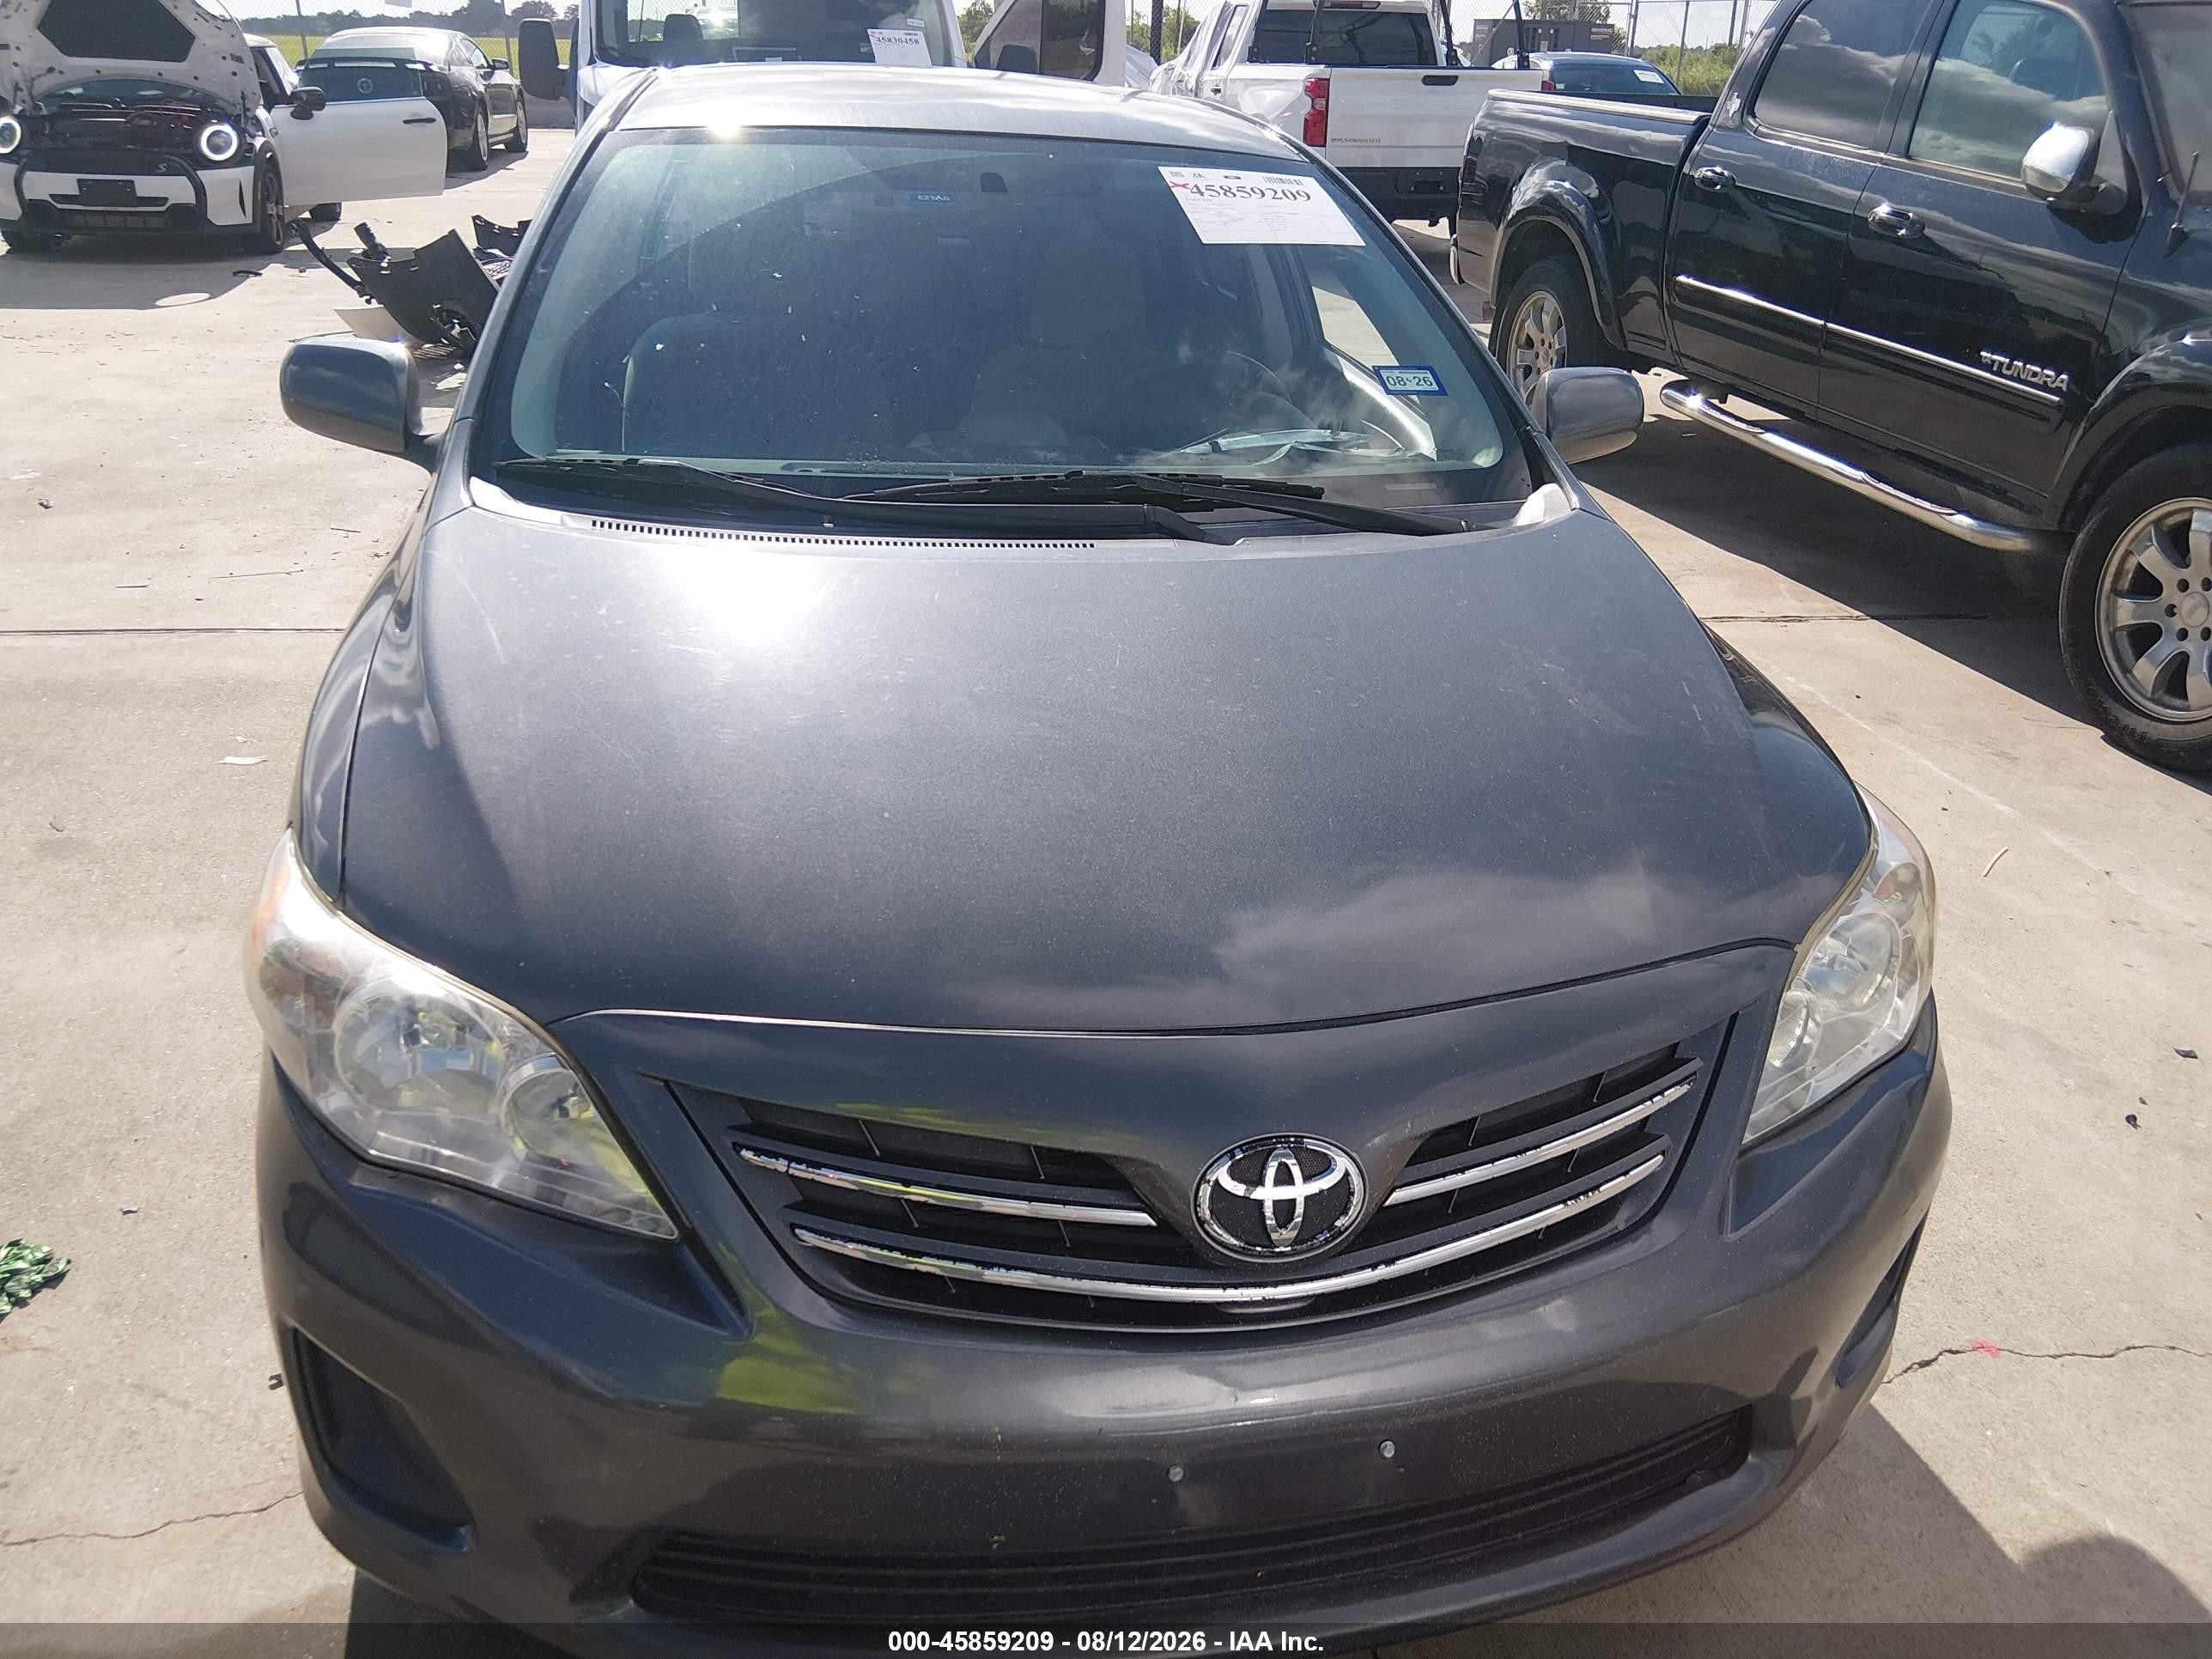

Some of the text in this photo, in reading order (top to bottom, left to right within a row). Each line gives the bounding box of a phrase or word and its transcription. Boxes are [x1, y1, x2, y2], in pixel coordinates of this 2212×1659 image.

[1190, 183, 1311, 202] 45859209
[1386, 375, 1433, 386] 08 26
[1990, 354, 2069, 392] TUNDRA
